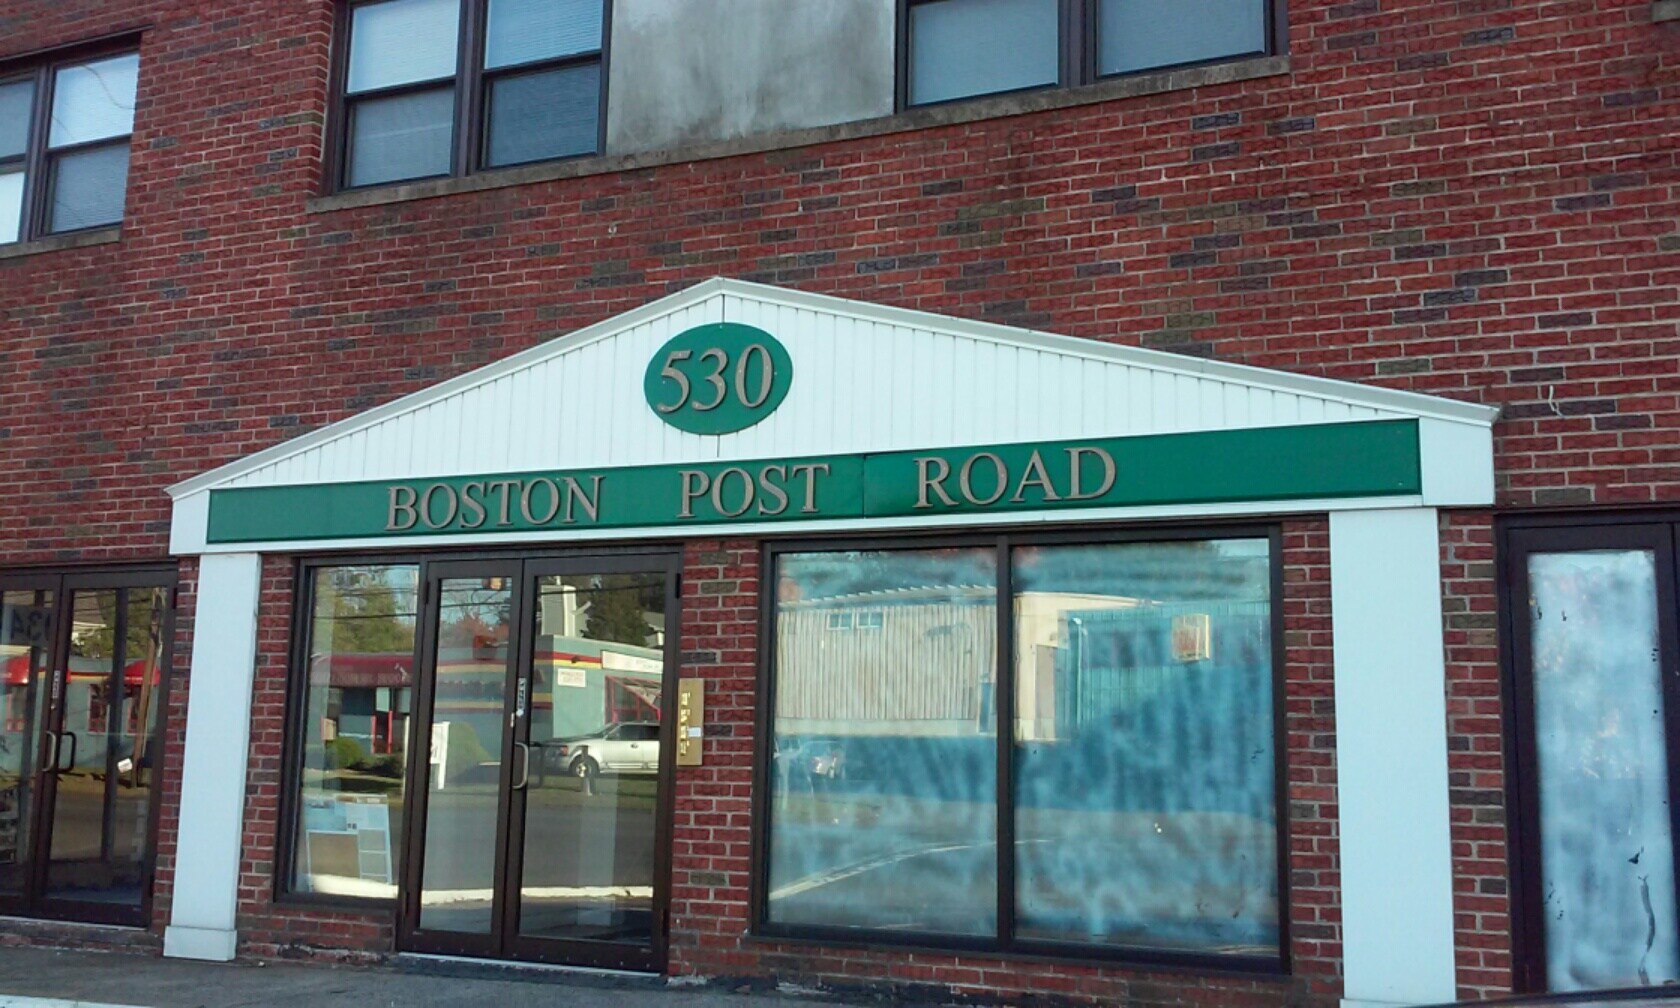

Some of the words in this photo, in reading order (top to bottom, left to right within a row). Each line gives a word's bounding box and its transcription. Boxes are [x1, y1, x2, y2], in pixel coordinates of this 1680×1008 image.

[656, 343, 774, 413] 530
[384, 475, 607, 531] BOSTON
[676, 462, 831, 519] POST
[912, 446, 1117, 509] ROAD
